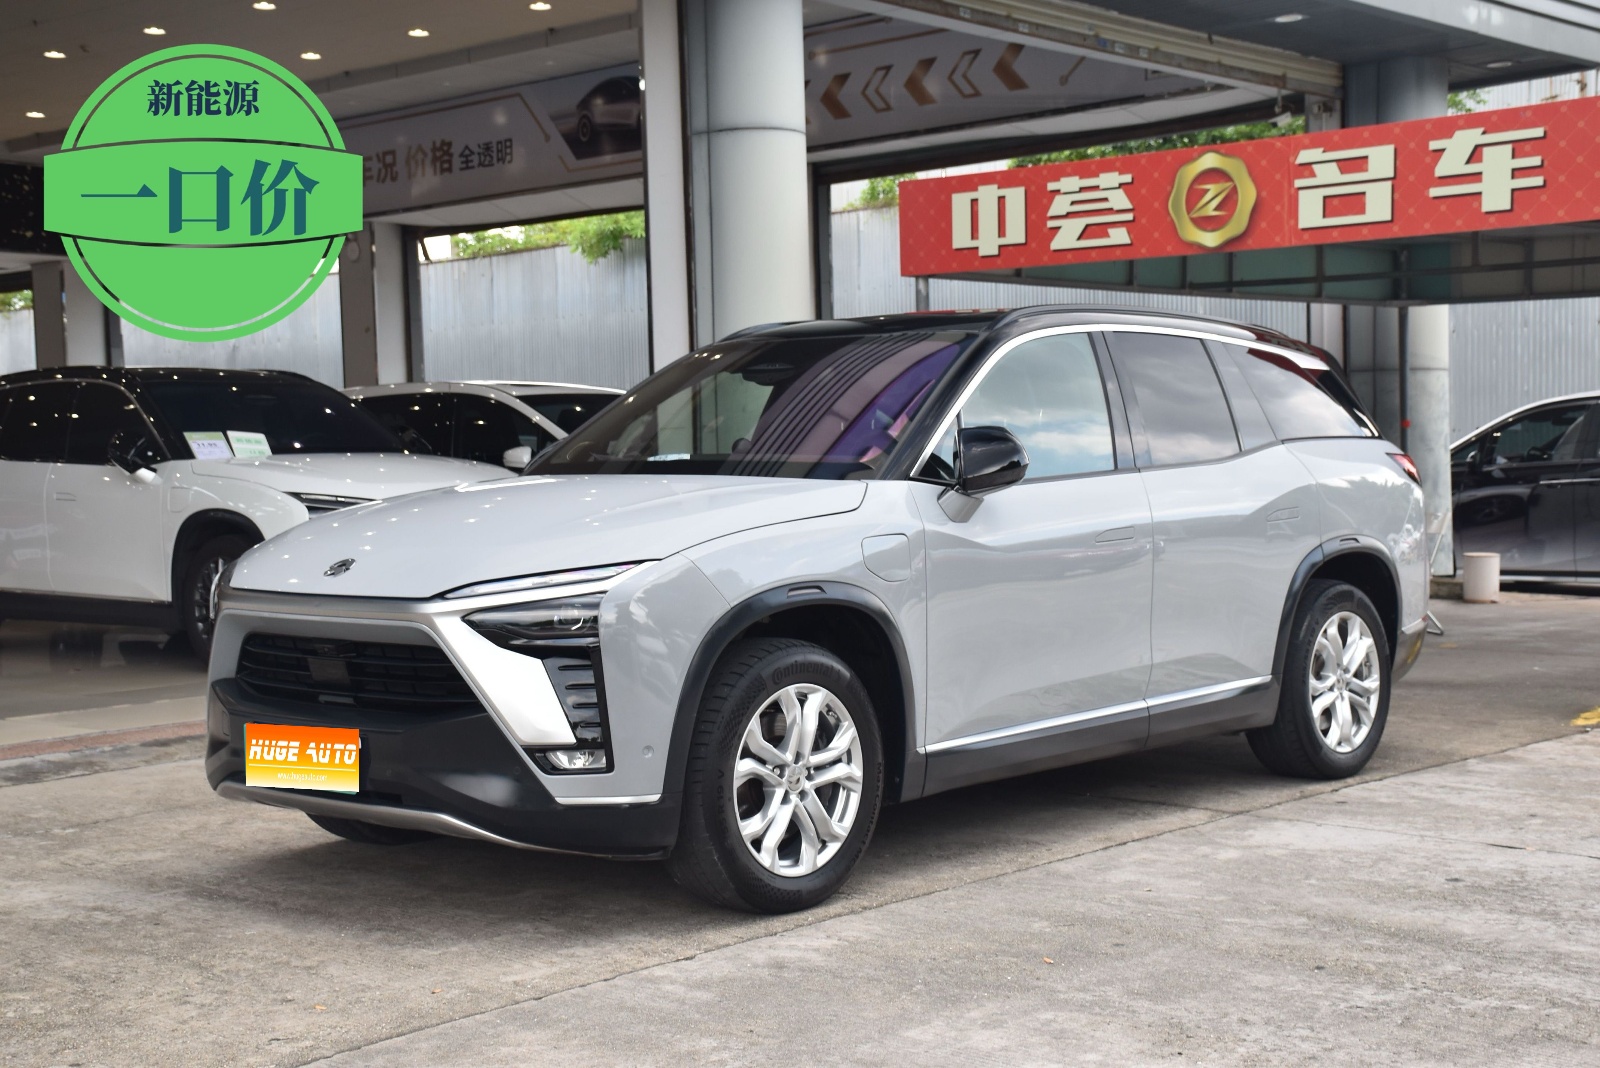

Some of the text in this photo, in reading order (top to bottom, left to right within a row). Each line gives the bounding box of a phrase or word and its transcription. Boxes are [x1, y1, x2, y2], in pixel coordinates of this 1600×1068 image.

[405, 137, 454, 180] 价格
[458, 137, 514, 171] 全透明
[951, 171, 1135, 257] 中荟
[1293, 126, 1546, 230] 名车
[772, 660, 834, 685] Continental
